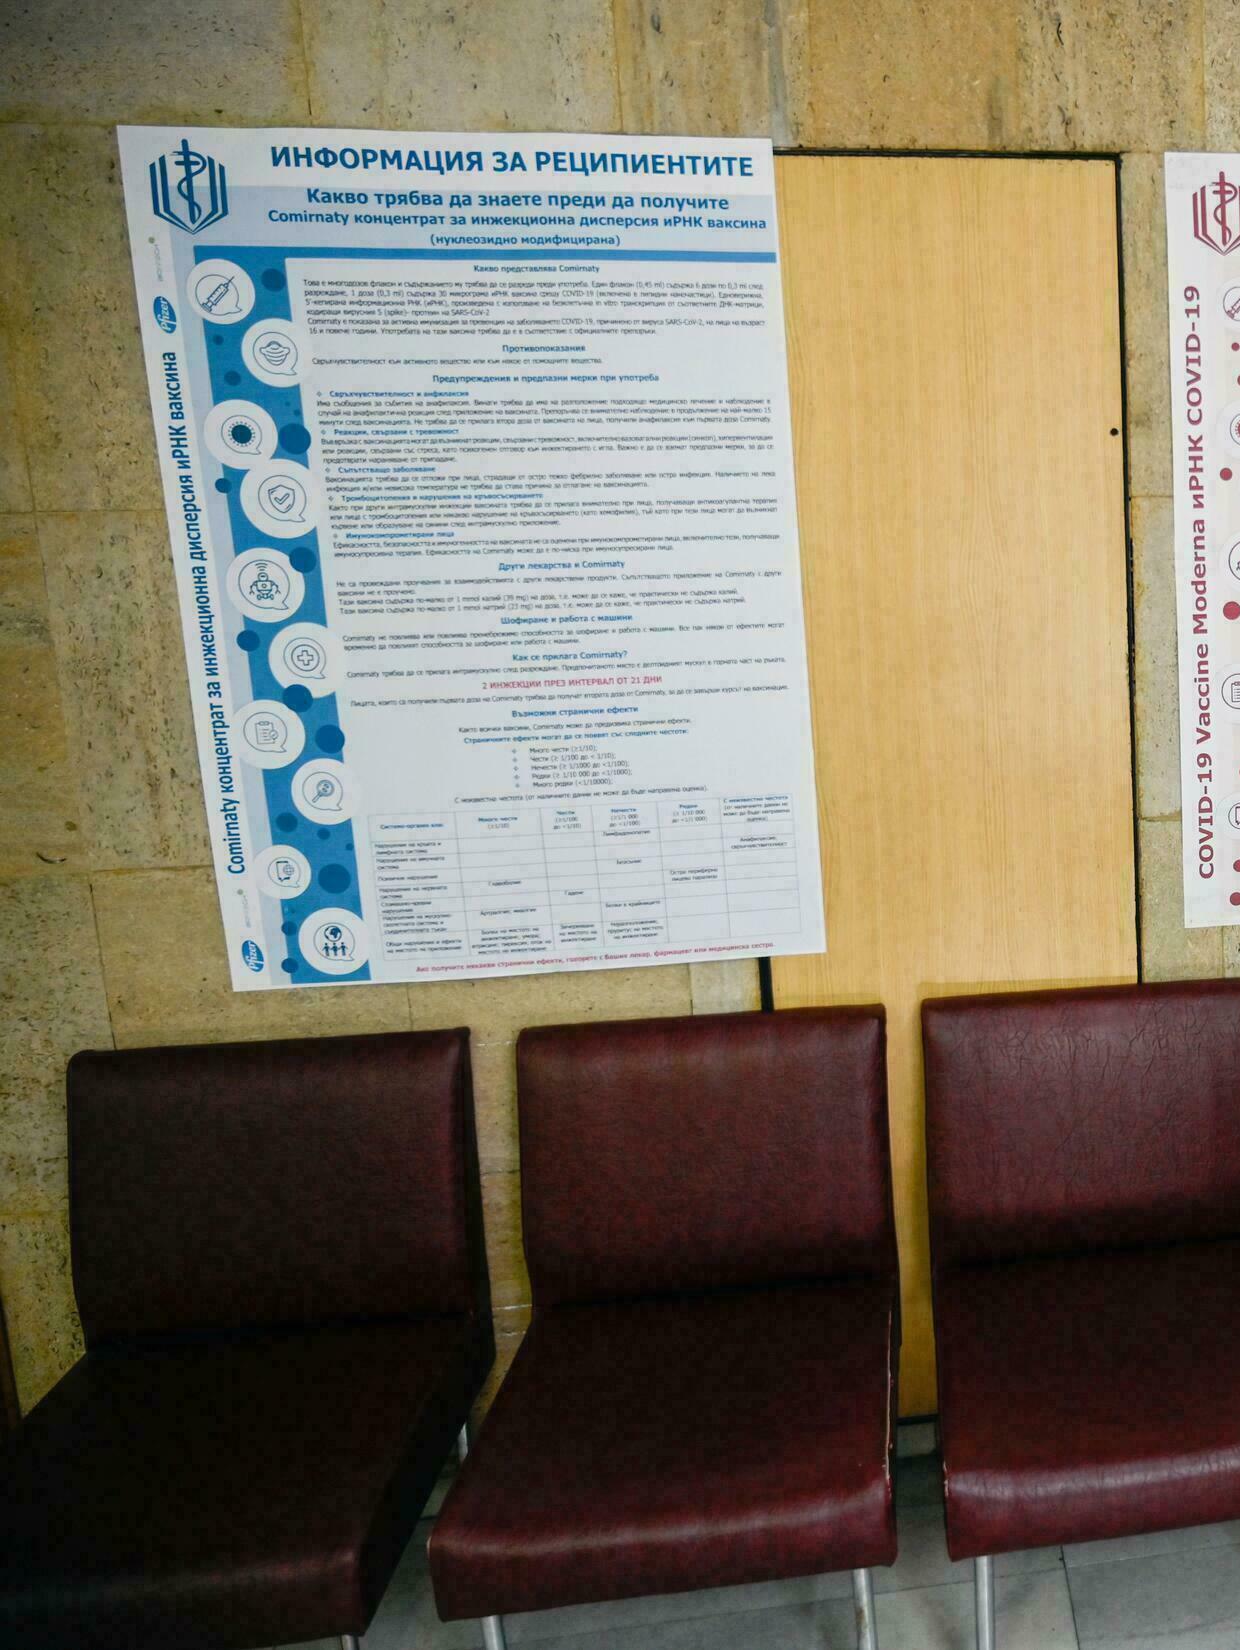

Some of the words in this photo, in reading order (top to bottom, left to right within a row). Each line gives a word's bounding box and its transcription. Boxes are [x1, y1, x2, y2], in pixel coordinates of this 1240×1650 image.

[270, 146, 483, 175] ИНФОРМАЦИЯ
[492, 151, 526, 172] ЗА
[535, 151, 752, 178] РЕЦИПИЕНТИТЕ
[306, 188, 368, 204] Какво
[374, 190, 444, 208] трябва
[448, 194, 472, 208] да
[478, 194, 542, 206] знаете
[548, 194, 605, 209] преди
[612, 196, 634, 208] да
[640, 196, 728, 212] получите
[267, 209, 348, 225] Comirnaty
[354, 214, 445, 227] концентрат
[449, 216, 466, 225] за
[470, 215, 575, 227] инжекционна
[579, 216, 658, 228] дисперсия
[663, 216, 702, 226] иРНК
[707, 219, 766, 228] ваксина
[430, 234, 517, 246] (нуклеозидно
[520, 234, 620, 245] модифицирана)
[559, 264, 599, 272] Comirnaty
[157, 297, 177, 332] Pfizer
[502, 344, 585, 353] Противопоказания
[1184, 286, 1202, 426] COVID-19
[162, 352, 184, 420] ваксина
[432, 374, 512, 383] Предупреждения
[618, 373, 659, 382] употреба
[169, 426, 190, 470] иРНК
[1188, 435, 1204, 509] иРНК
[180, 475, 207, 562] дисперсия
[498, 562, 525, 571] Други
[526, 562, 572, 570] лекарства
[580, 560, 624, 568] Comirnaty
[1192, 520, 1208, 635] Moderna
[192, 566, 218, 677] инжекционна
[500, 616, 549, 625] Шофиране
[558, 615, 588, 623] работа
[512, 653, 528, 661] Как
[542, 653, 578, 661] прилага
[579, 650, 627, 659] Comirnaty?
[208, 682, 221, 698] за
[489, 680, 541, 689] ИНЖЕКЦИИ
[543, 679, 565, 687] ПРЕЗ
[568, 677, 614, 686] ИНТЕРВАЛ
[642, 675, 662, 684] ДНИ
[1194, 644, 1212, 745] Vaccine
[511, 708, 557, 717] Възможни
[558, 708, 604, 716] странични
[606, 705, 638, 714] ефекти
[211, 704, 234, 793] концентрат
[1196, 754, 1214, 879] COVID-19
[222, 799, 246, 874] Comirnaty
[245, 940, 264, 970] Pfizer
